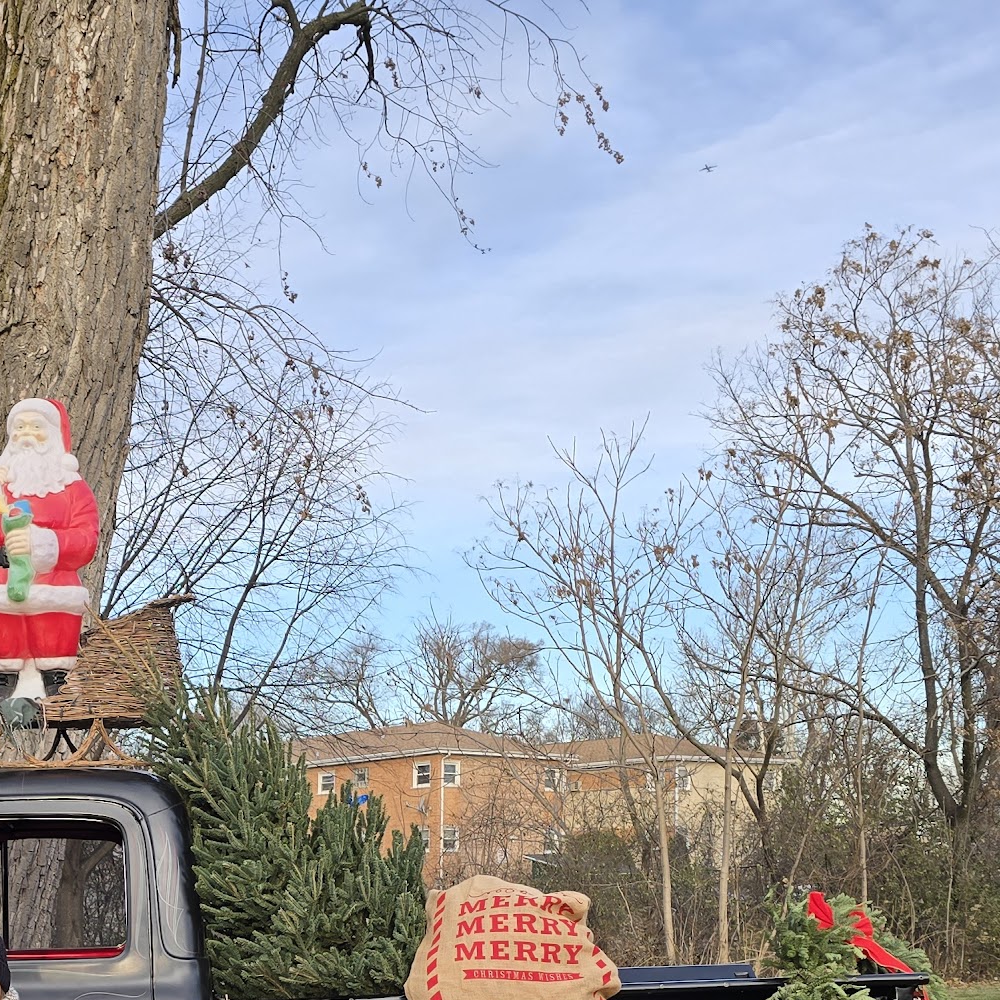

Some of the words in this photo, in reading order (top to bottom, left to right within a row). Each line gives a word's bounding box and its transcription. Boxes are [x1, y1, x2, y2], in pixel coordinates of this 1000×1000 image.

[455, 913, 579, 938] MERRY
[454, 940, 584, 965] MERRY
[473, 970, 533, 981] CHRISTMAS
[539, 972, 575, 981] WISHES
